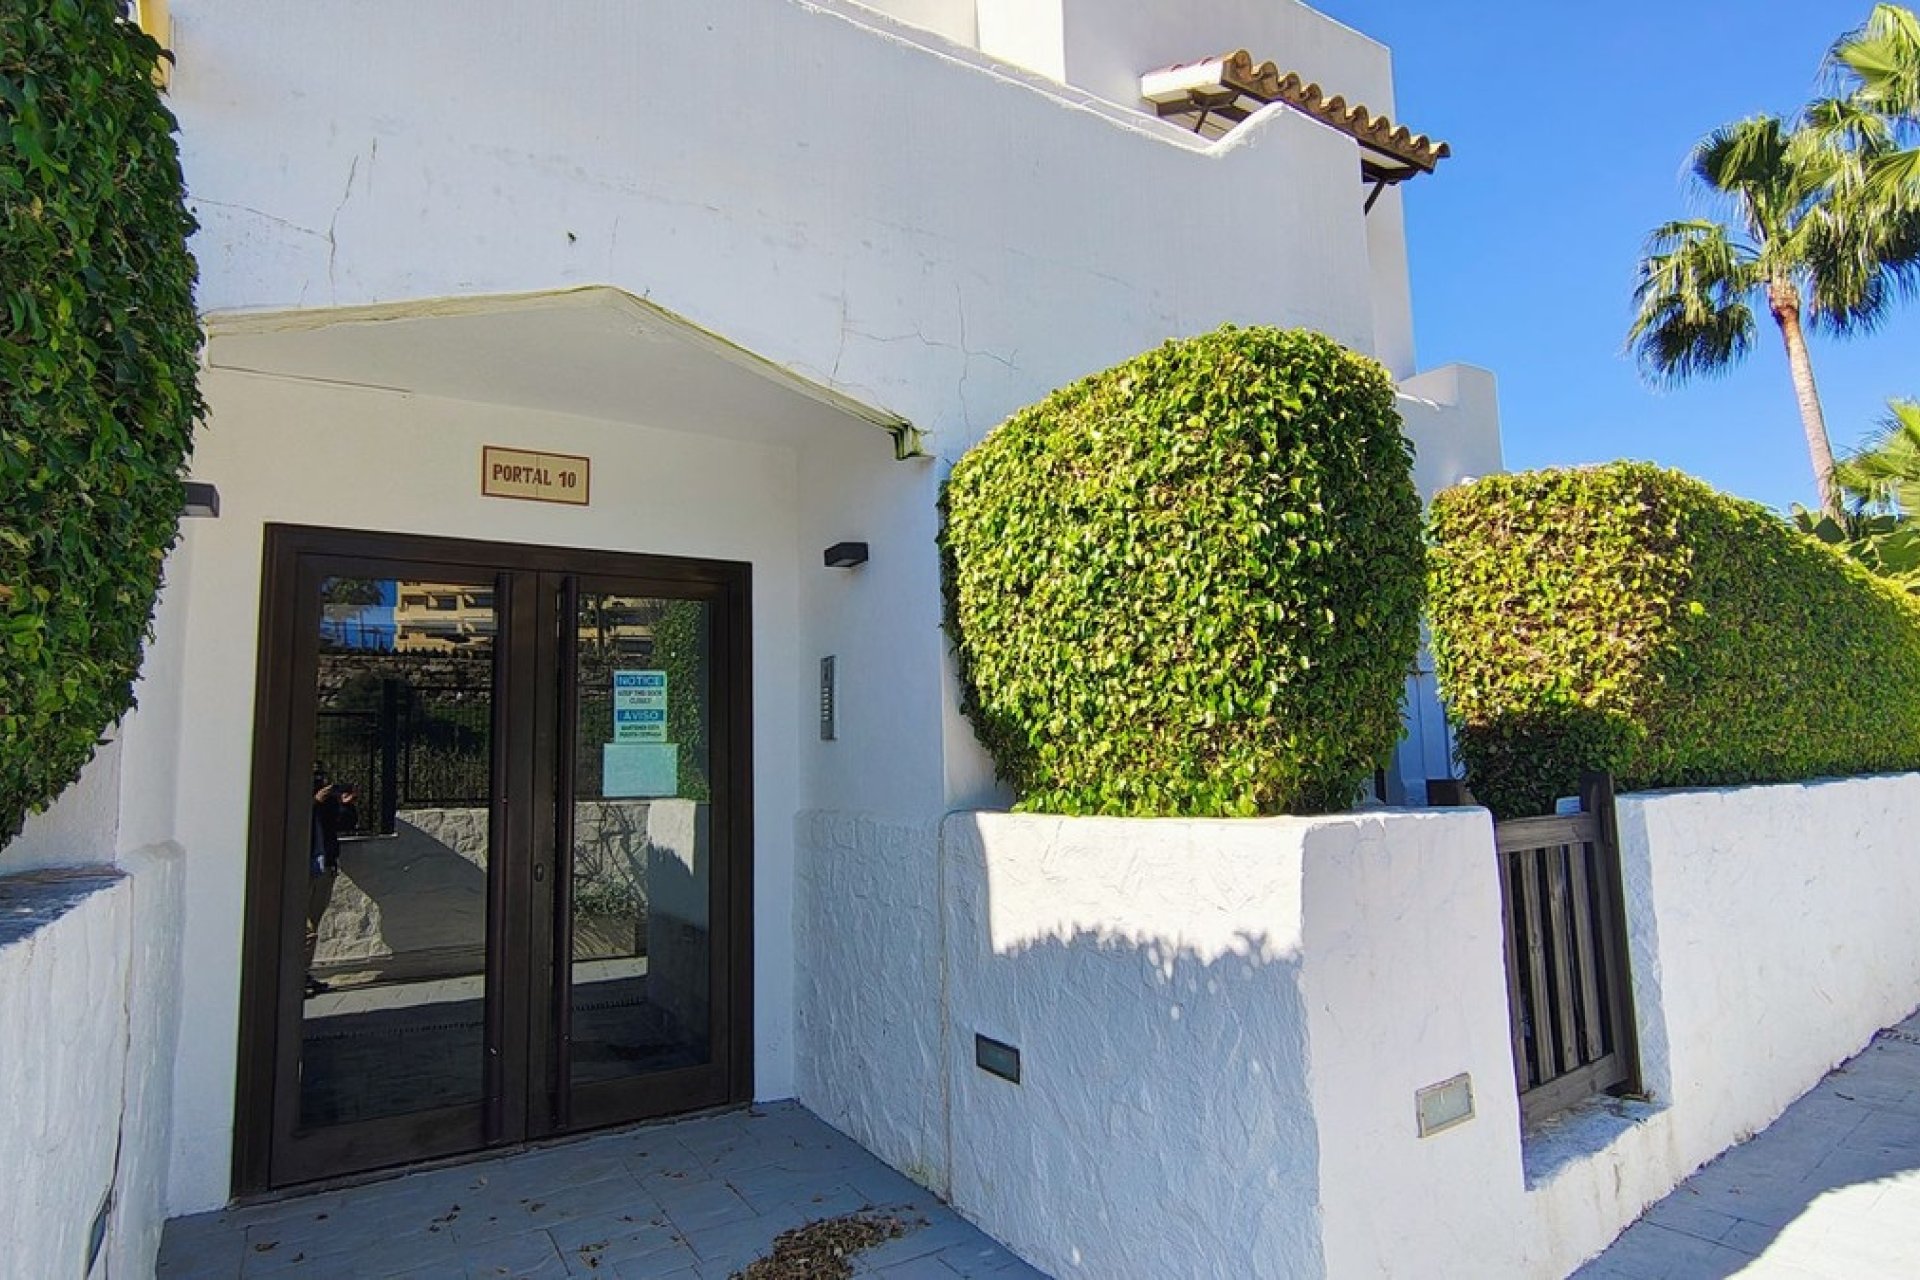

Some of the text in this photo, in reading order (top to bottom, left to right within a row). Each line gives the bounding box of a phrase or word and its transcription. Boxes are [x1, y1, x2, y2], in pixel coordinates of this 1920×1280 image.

[493, 464, 576, 488] PORTAL 10
[619, 676, 660, 685] NOTICE
[623, 710, 659, 720] AVISO
